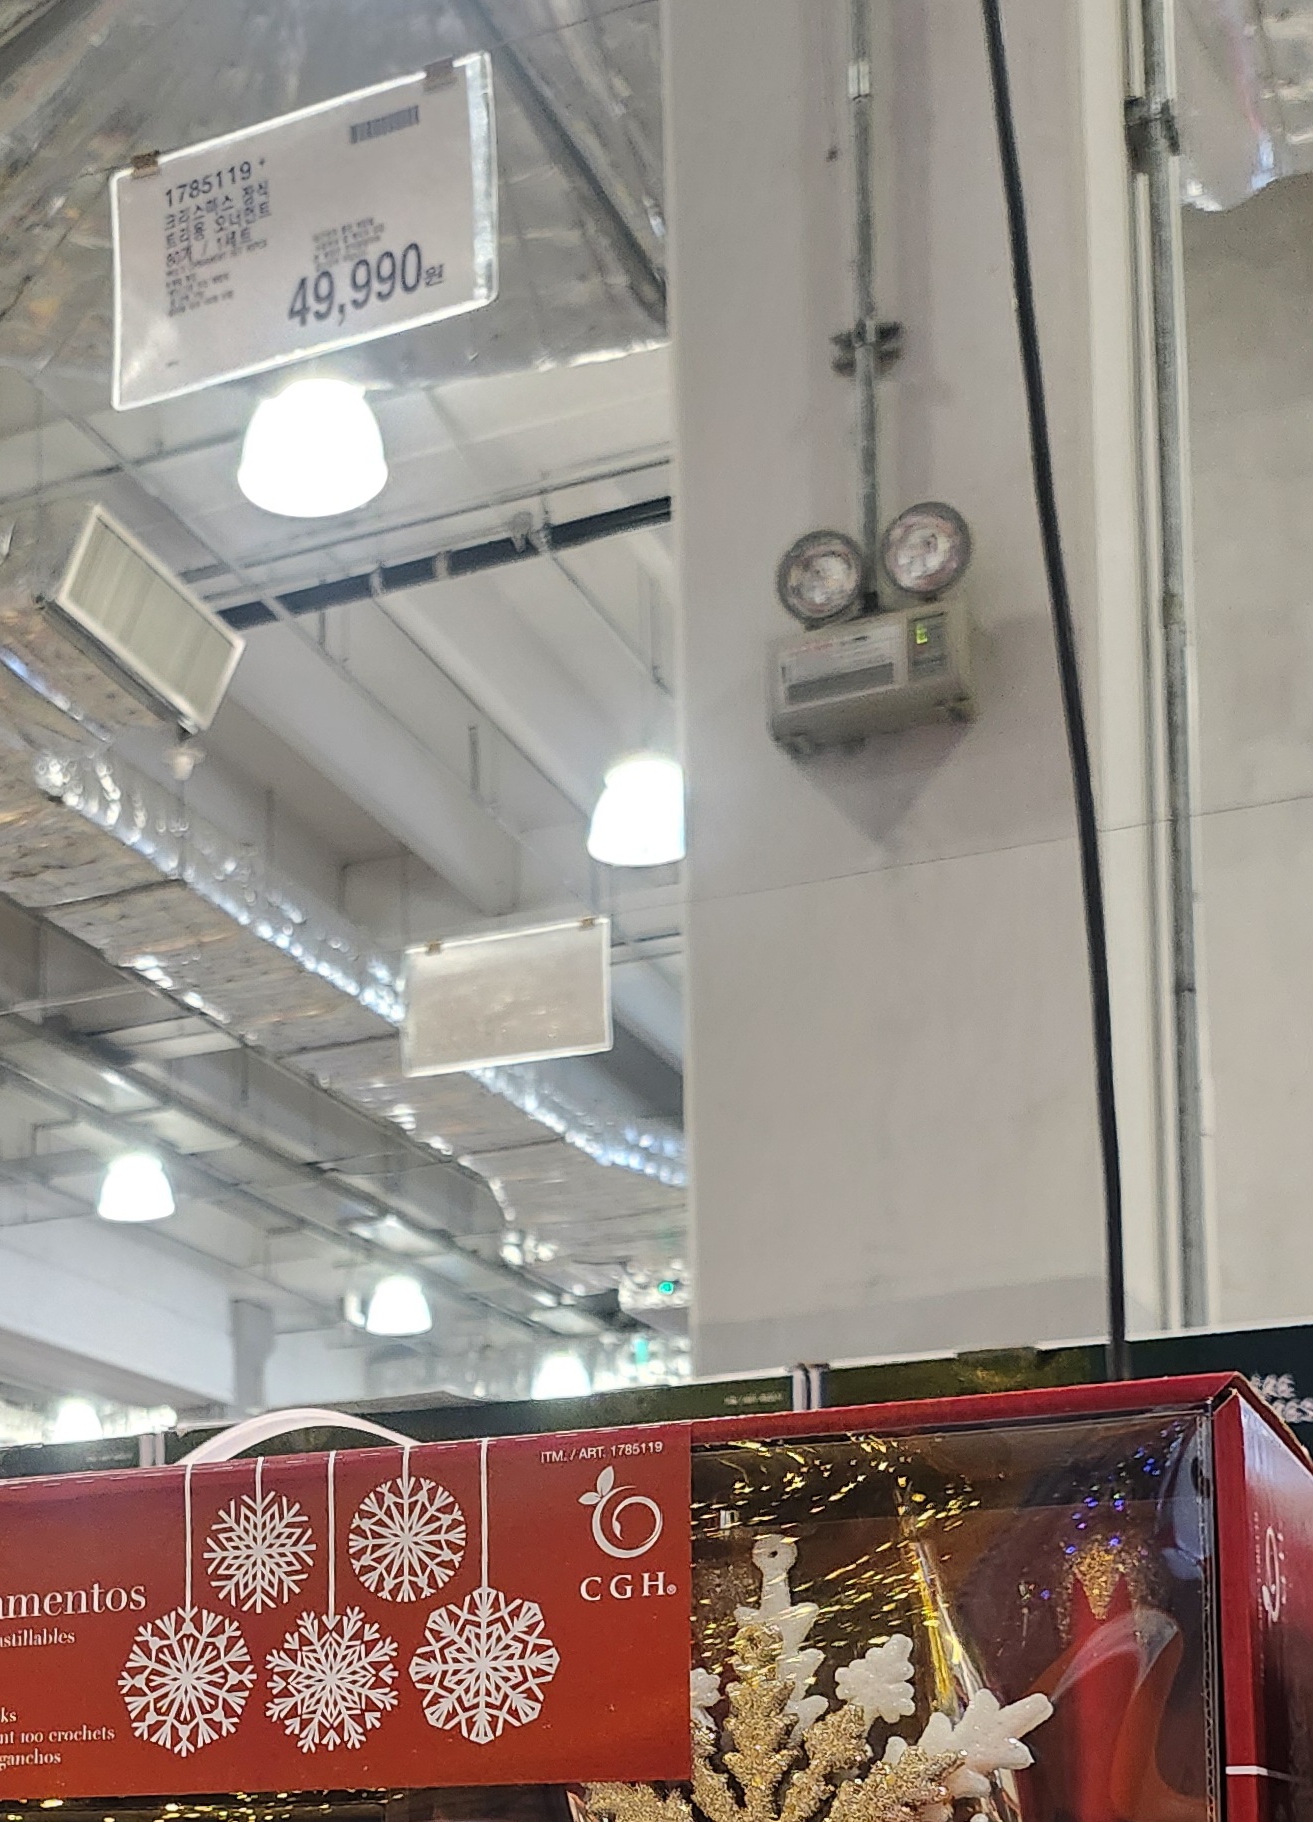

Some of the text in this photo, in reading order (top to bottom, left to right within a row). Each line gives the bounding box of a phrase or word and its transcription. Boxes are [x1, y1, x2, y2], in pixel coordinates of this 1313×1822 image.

[165, 161, 252, 208] 1785119
[610, 1441, 663, 1457] 1785119
[19, 1728, 44, 1744] 100
[48, 1724, 116, 1745] crochets
